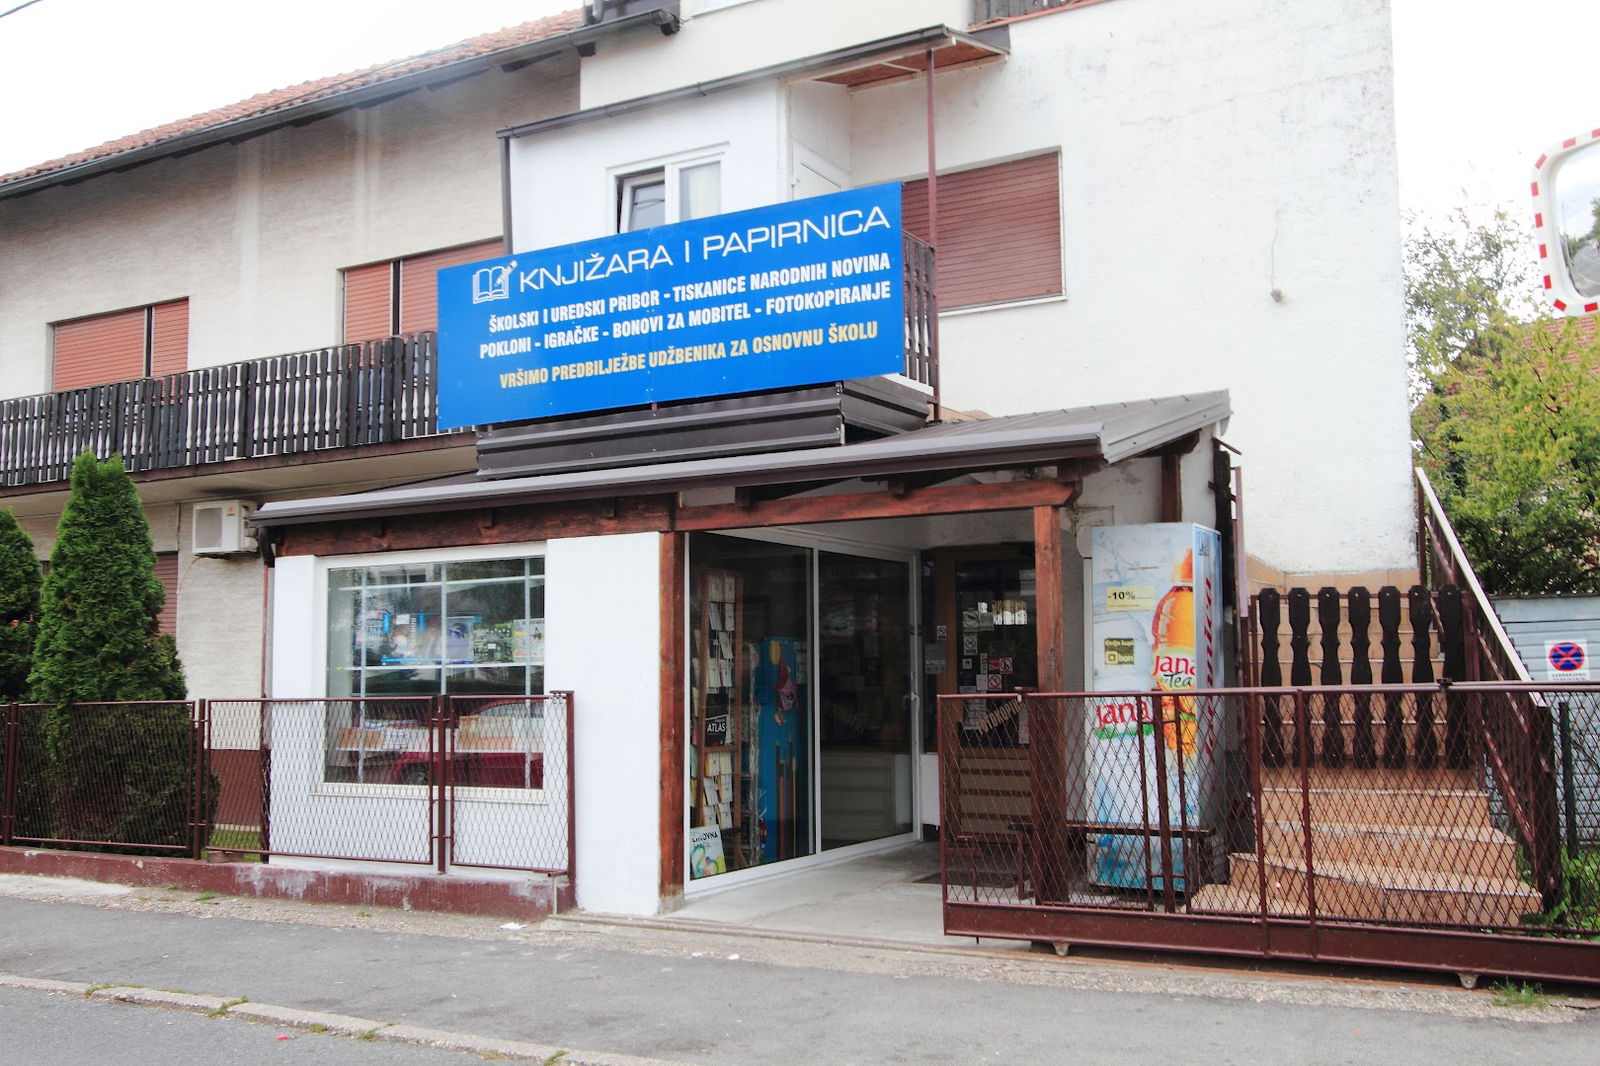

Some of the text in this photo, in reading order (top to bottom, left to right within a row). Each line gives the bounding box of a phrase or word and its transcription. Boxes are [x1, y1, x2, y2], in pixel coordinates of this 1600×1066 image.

[519, 205, 891, 293] KNJIŽARA I PAPIRNICA
[479, 336, 532, 360] POKLONI
[543, 325, 599, 349] IGRAČKE
[612, 315, 664, 339] BONOVI
[666, 312, 686, 330] ZA
[688, 302, 752, 327] MOBITEL
[765, 280, 891, 316] FOTOKOPIRANJE
[488, 310, 540, 334] ŠKOLSKI
[542, 308, 549, 324] I
[550, 298, 606, 323] UREDSKI
[608, 289, 660, 313] PRIBOR
[672, 275, 747, 303] TISKANICE
[749, 264, 827, 291] NARODNIH
[831, 252, 891, 278] NOVINA
[499, 320, 878, 389] VRŠIMO PREDBILJEŽBE UDŽBENIKA ZA OSNOVNU ŠKOLU
[1163, 671, 1192, 688] Tea
[706, 722, 726, 733] ATLAS
